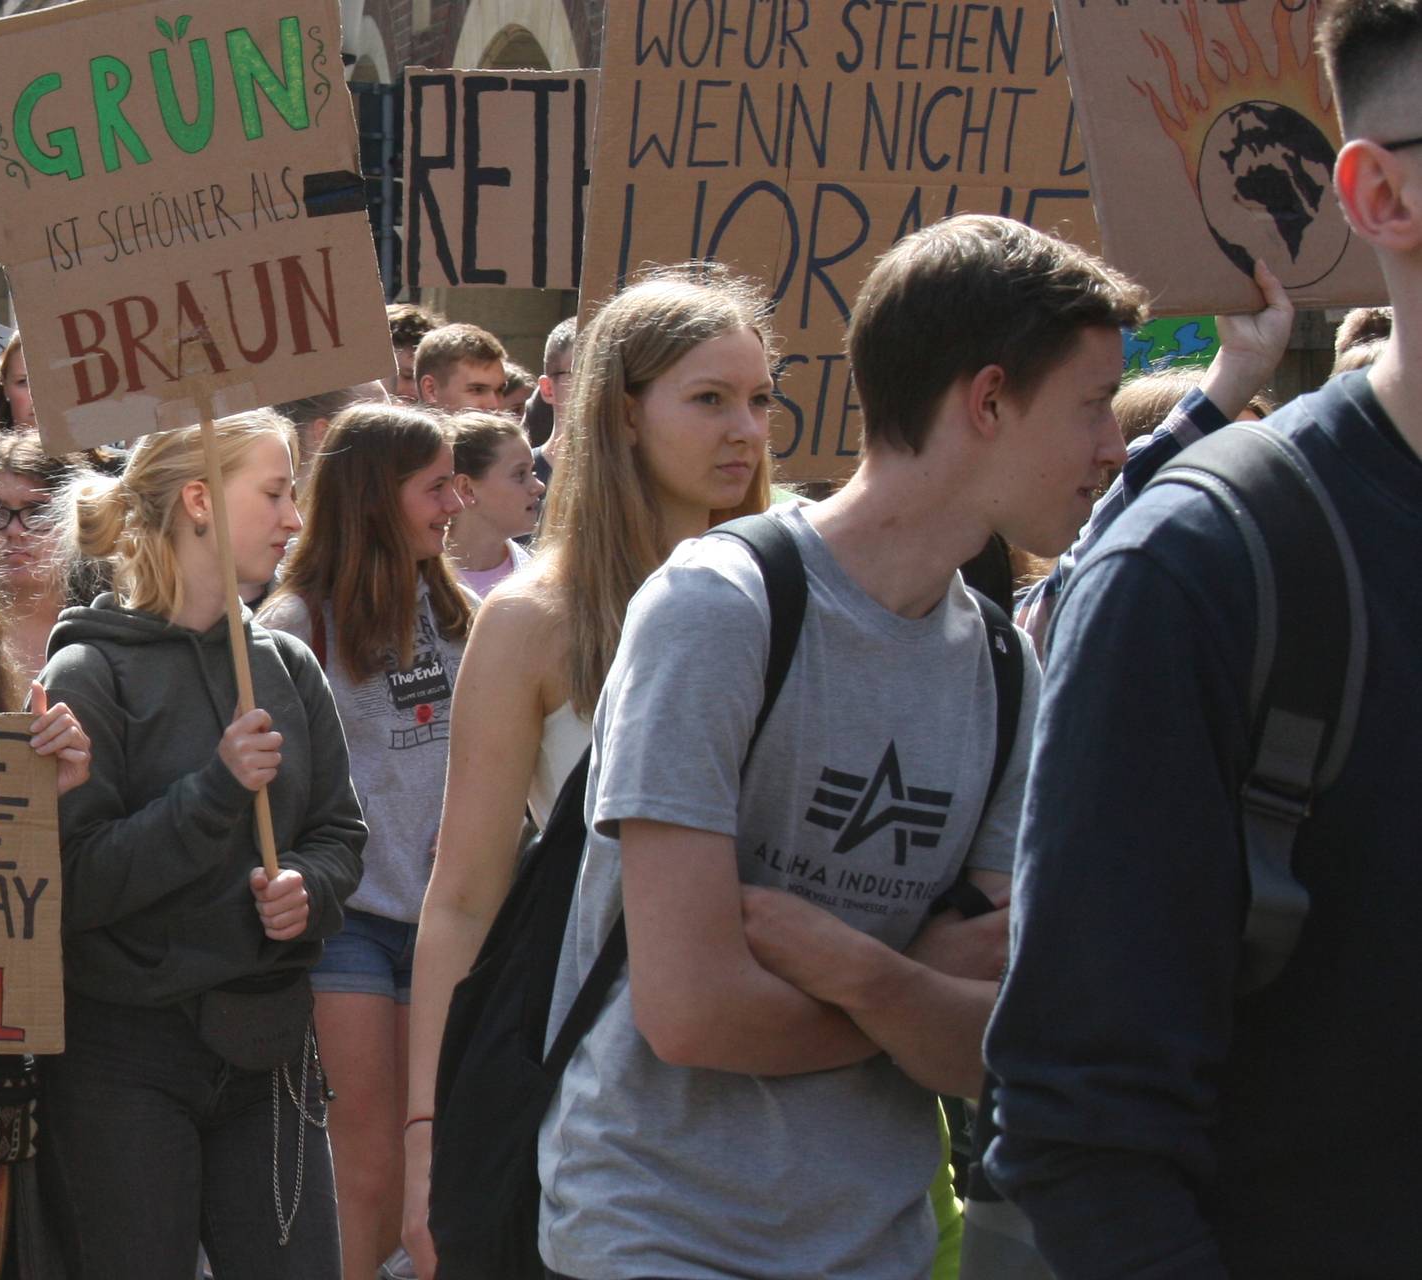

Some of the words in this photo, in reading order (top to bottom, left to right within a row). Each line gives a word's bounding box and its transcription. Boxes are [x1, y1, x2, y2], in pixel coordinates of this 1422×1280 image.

[835, 0, 1024, 75] STEHEN
[12, 15, 310, 182] GRÜN
[628, 79, 833, 169] WENN
[858, 80, 1038, 175] NICHT
[45, 216, 82, 273] IST
[97, 183, 243, 263] SCHÖNER
[249, 166, 300, 230] ALS
[57, 246, 345, 406] BRAUN
[389, 670, 415, 687] The
[414, 661, 444, 681] End
[753, 841, 828, 887] ALHA
